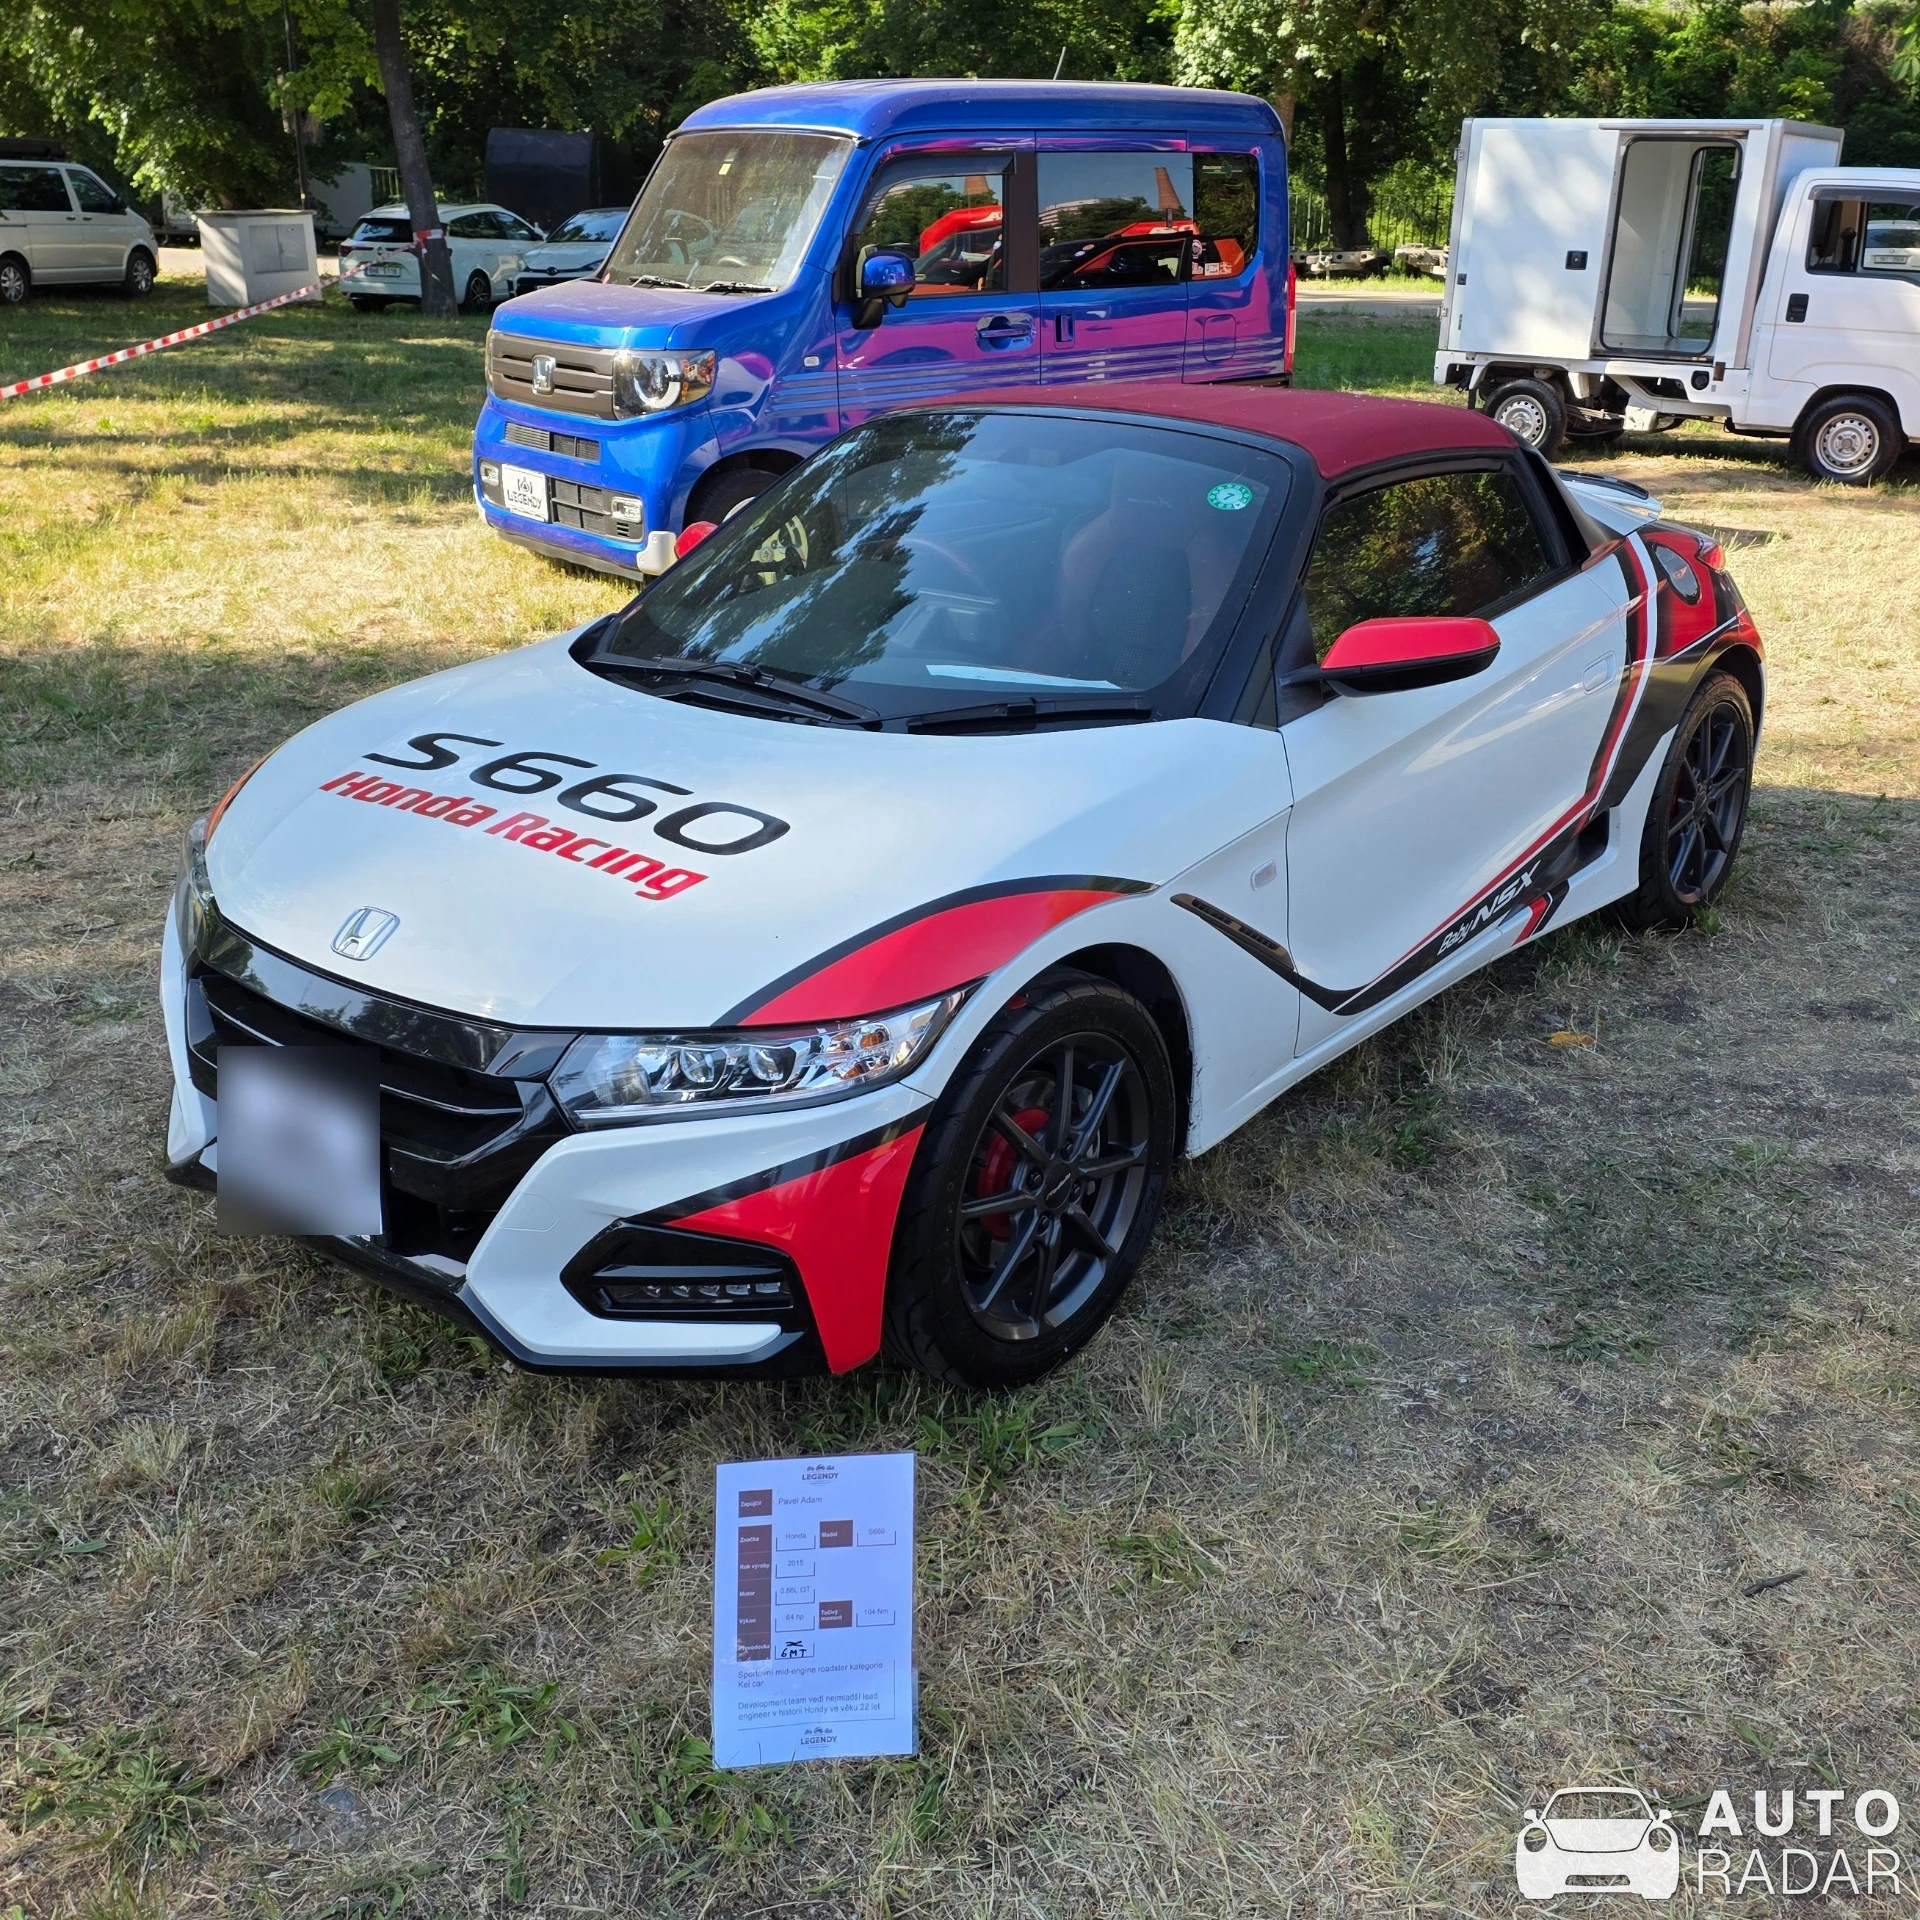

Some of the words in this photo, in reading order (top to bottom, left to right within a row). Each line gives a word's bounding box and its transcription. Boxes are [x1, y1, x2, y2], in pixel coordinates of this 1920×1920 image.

[507, 489, 542, 509] LEGENDY
[361, 732, 791, 856] S660
[318, 771, 499, 828] Honda
[482, 812, 709, 901] Racing
[1437, 919, 1474, 955] Baby
[1471, 859, 1542, 929] NSX
[802, 1472, 839, 1481] LEGENDY
[778, 1497, 799, 1505] Pavel
[801, 1496, 823, 1504] Adam
[785, 1532, 807, 1540] Honda
[787, 1559, 804, 1567] 2015
[864, 1608, 876, 1616] 104
[877, 1607, 889, 1615] Nm
[785, 1613, 794, 1621] 64
[795, 1613, 805, 1622] hp
[775, 1665, 816, 1676] mid-engine
[817, 1664, 848, 1673] roadster
[849, 1661, 883, 1671] kategorie
[752, 1680, 764, 1688] car
[738, 1697, 787, 1710] Development
[788, 1697, 806, 1705] team
[808, 1695, 824, 1703] vedl
[862, 1691, 878, 1701] lead
[738, 1710, 770, 1721] engineer
[804, 1705, 828, 1715] Hondy
[840, 1703, 858, 1712] věku
[859, 1702, 869, 1711] 22
[870, 1702, 880, 1710] let
[801, 1735, 838, 1745] LEGENDY
